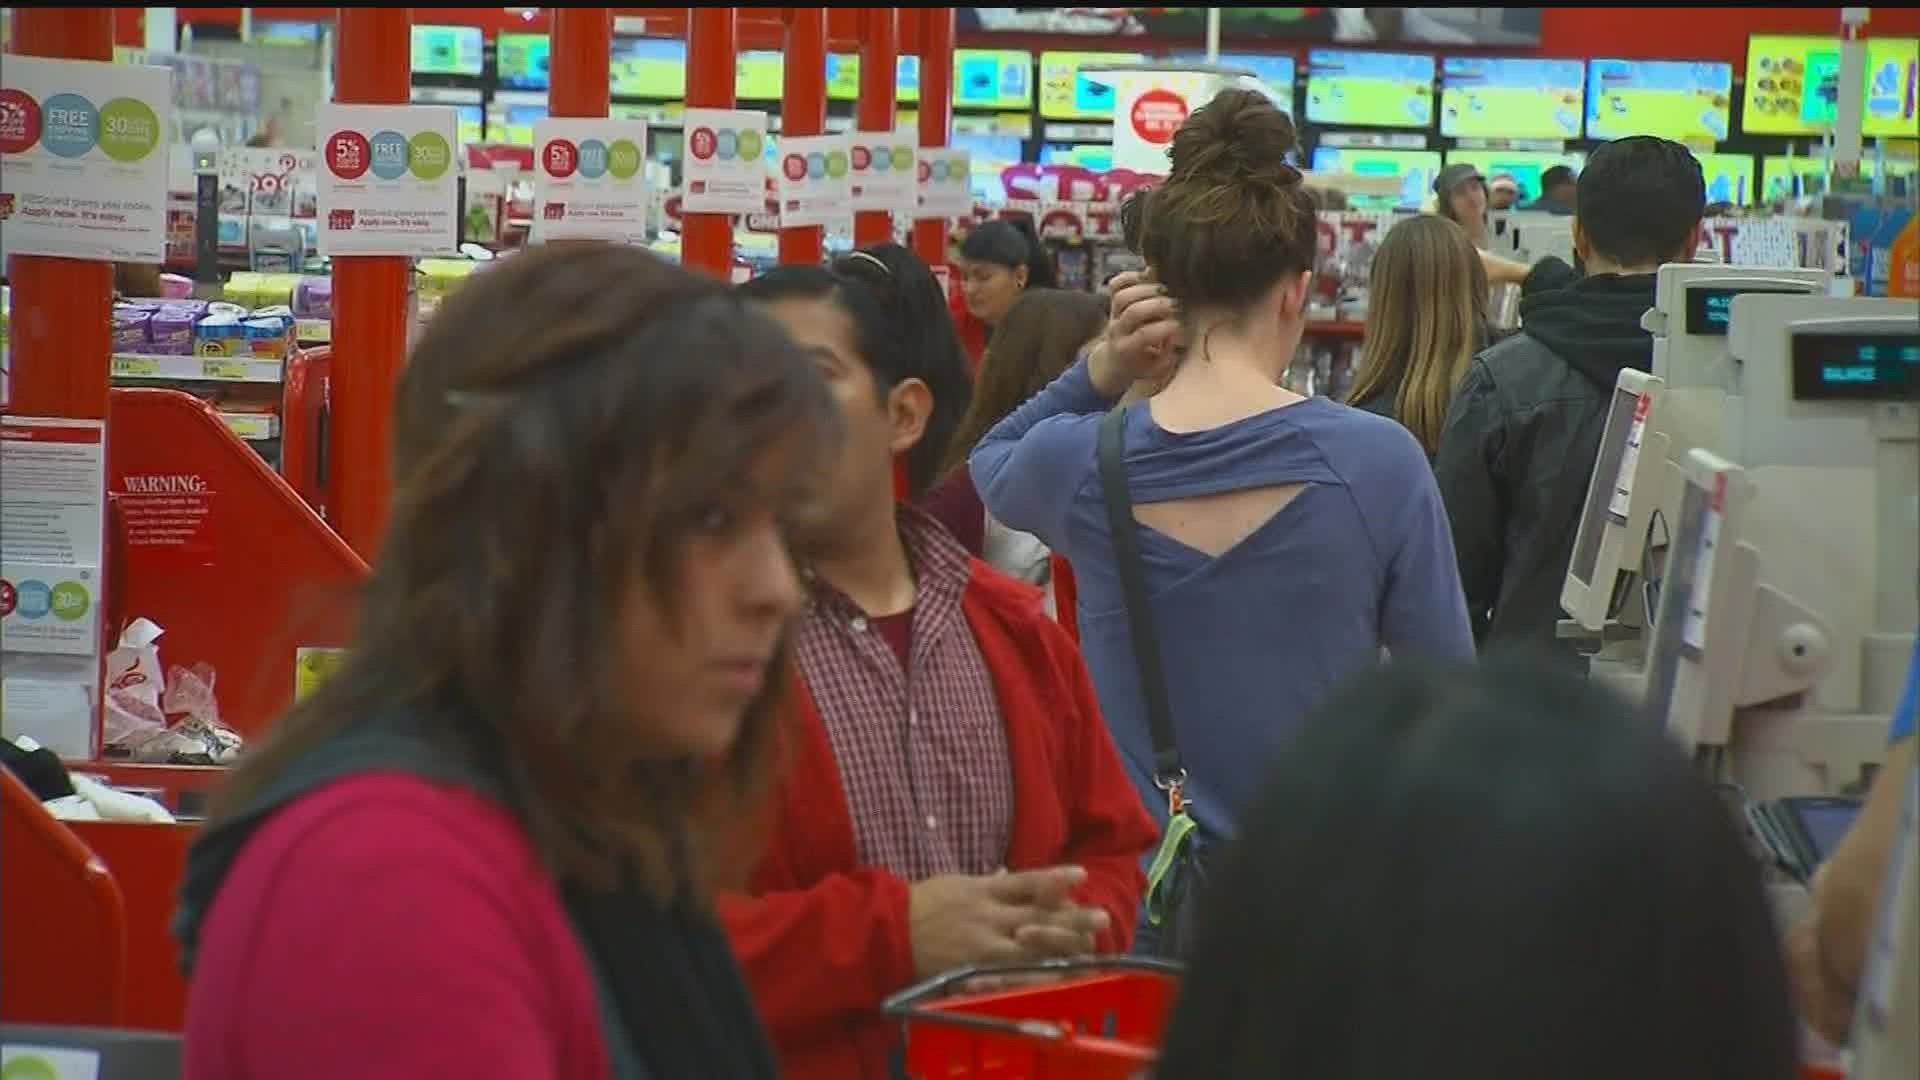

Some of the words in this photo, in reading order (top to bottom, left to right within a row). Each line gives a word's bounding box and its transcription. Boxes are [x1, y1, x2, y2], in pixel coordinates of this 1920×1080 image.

[48, 109, 89, 126] FREE
[106, 116, 128, 135] 30
[336, 139, 360, 157] 5%
[375, 143, 401, 154] FREE
[20, 206, 51, 218] Apply
[123, 474, 207, 492] WARNING:
